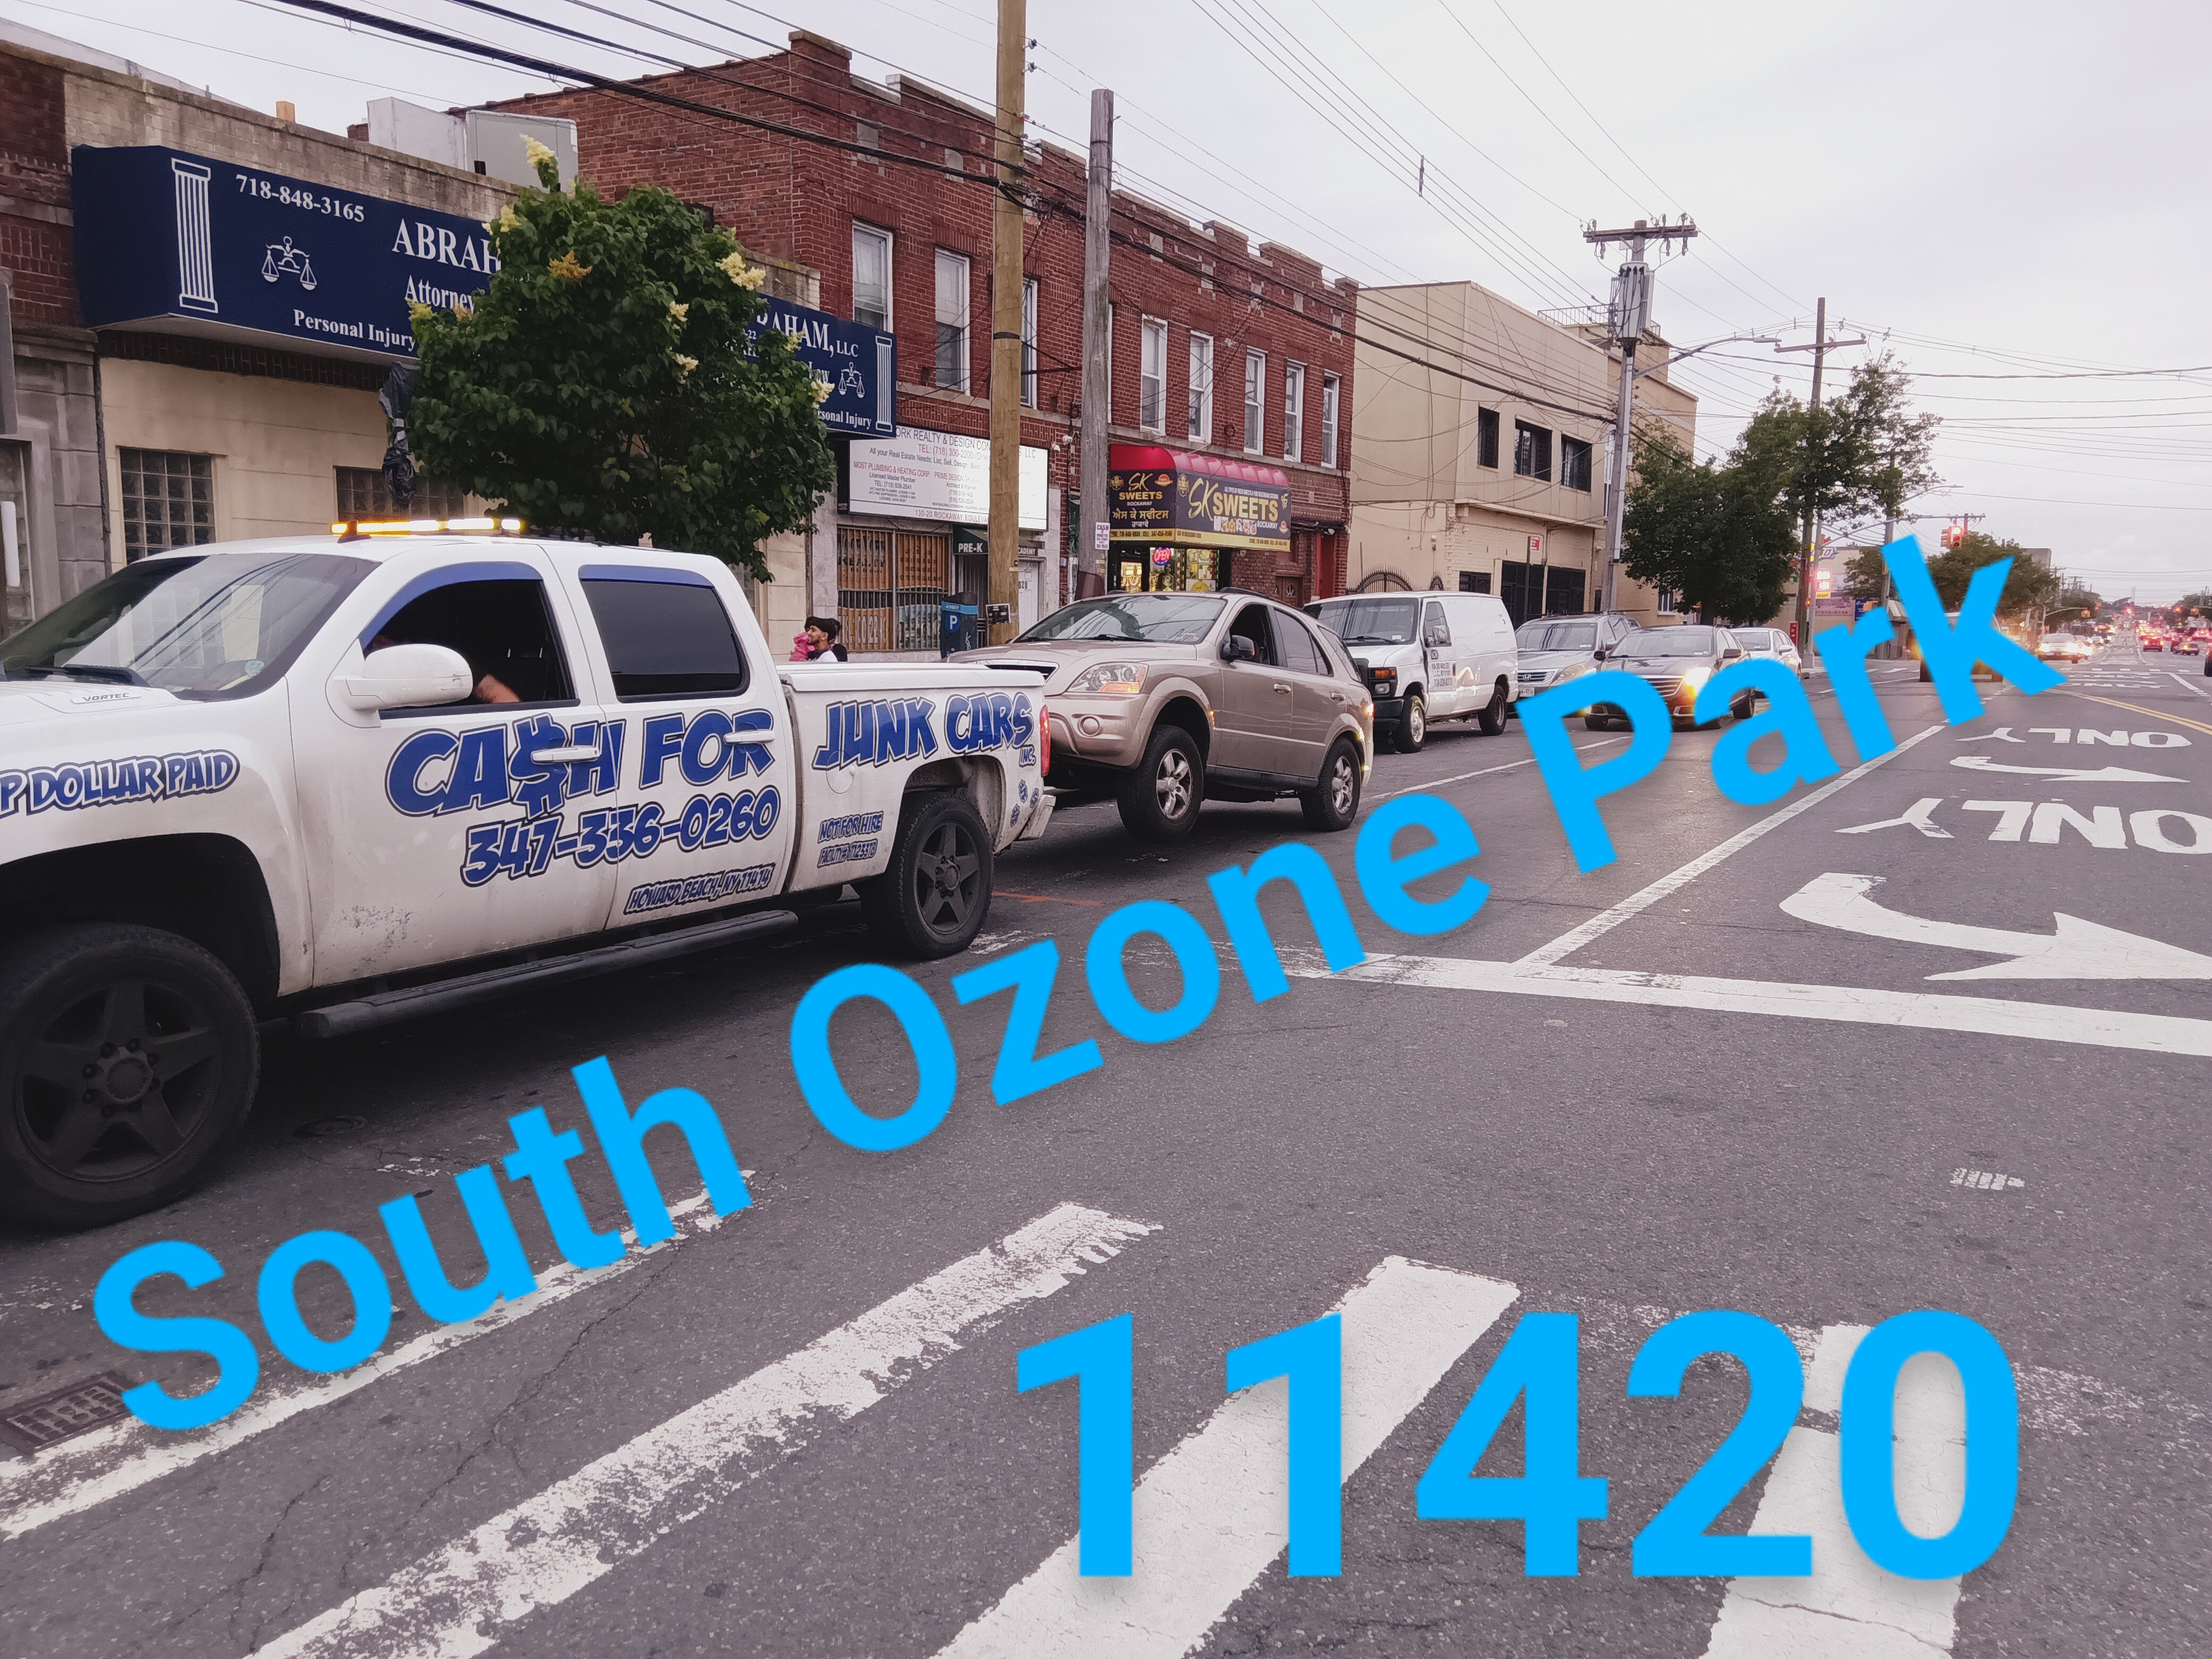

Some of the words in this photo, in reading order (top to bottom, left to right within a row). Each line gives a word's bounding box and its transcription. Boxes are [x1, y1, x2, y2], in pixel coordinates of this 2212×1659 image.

[236, 174, 364, 222] 718-848-3165
[392, 218, 501, 274] ABRAH
[294, 310, 364, 339] Personal
[368, 324, 416, 351] Injury
[836, 340, 858, 357] LLC
[817, 410, 843, 423] rsonal
[846, 412, 872, 430] Injury
[896, 427, 911, 439] ORK
[914, 429, 941, 443] REALTY
[943, 436, 948, 445] &
[950, 436, 975, 448] DESIGN
[977, 440, 990, 450] CON
[933, 446, 947, 457] (718)
[949, 448, 974, 459] 300-2200
[868, 463, 892, 472] PLUMBING
[898, 467, 916, 476] HEATING
[917, 470, 931, 478] CORP.
[935, 471, 948, 480] PRIME
[1128, 472, 1153, 491] SK
[1119, 491, 1163, 500] SWEETS
[1188, 477, 1218, 521] SK
[1213, 492, 1278, 522] SWEETS
[934, 512, 963, 521] ROCKAWAY
[1257, 521, 1278, 529] ROCKAWAY
[959, 543, 983, 553] PRE-K
[1154, 549, 1170, 562] OPEN
[811, 696, 939, 771] JUNK
[944, 692, 1033, 755] CARS
[1955, 727, 2191, 748] ONLY
[639, 708, 775, 791] FOR
[1019, 744, 1036, 767] INC.
[27, 756, 162, 816] DOLLAR
[162, 749, 240, 800] PAID
[460, 785, 781, 887] 347-336-0260
[817, 818, 842, 844] NOT
[839, 814, 861, 839] FOR
[858, 810, 884, 835] HIRE
[1834, 798, 2212, 854] ONLY
[624, 879, 683, 914] HOWARD
[679, 872, 722, 902] BEACH,
[720, 869, 741, 896] NY
[735, 862, 775, 893] 11414
